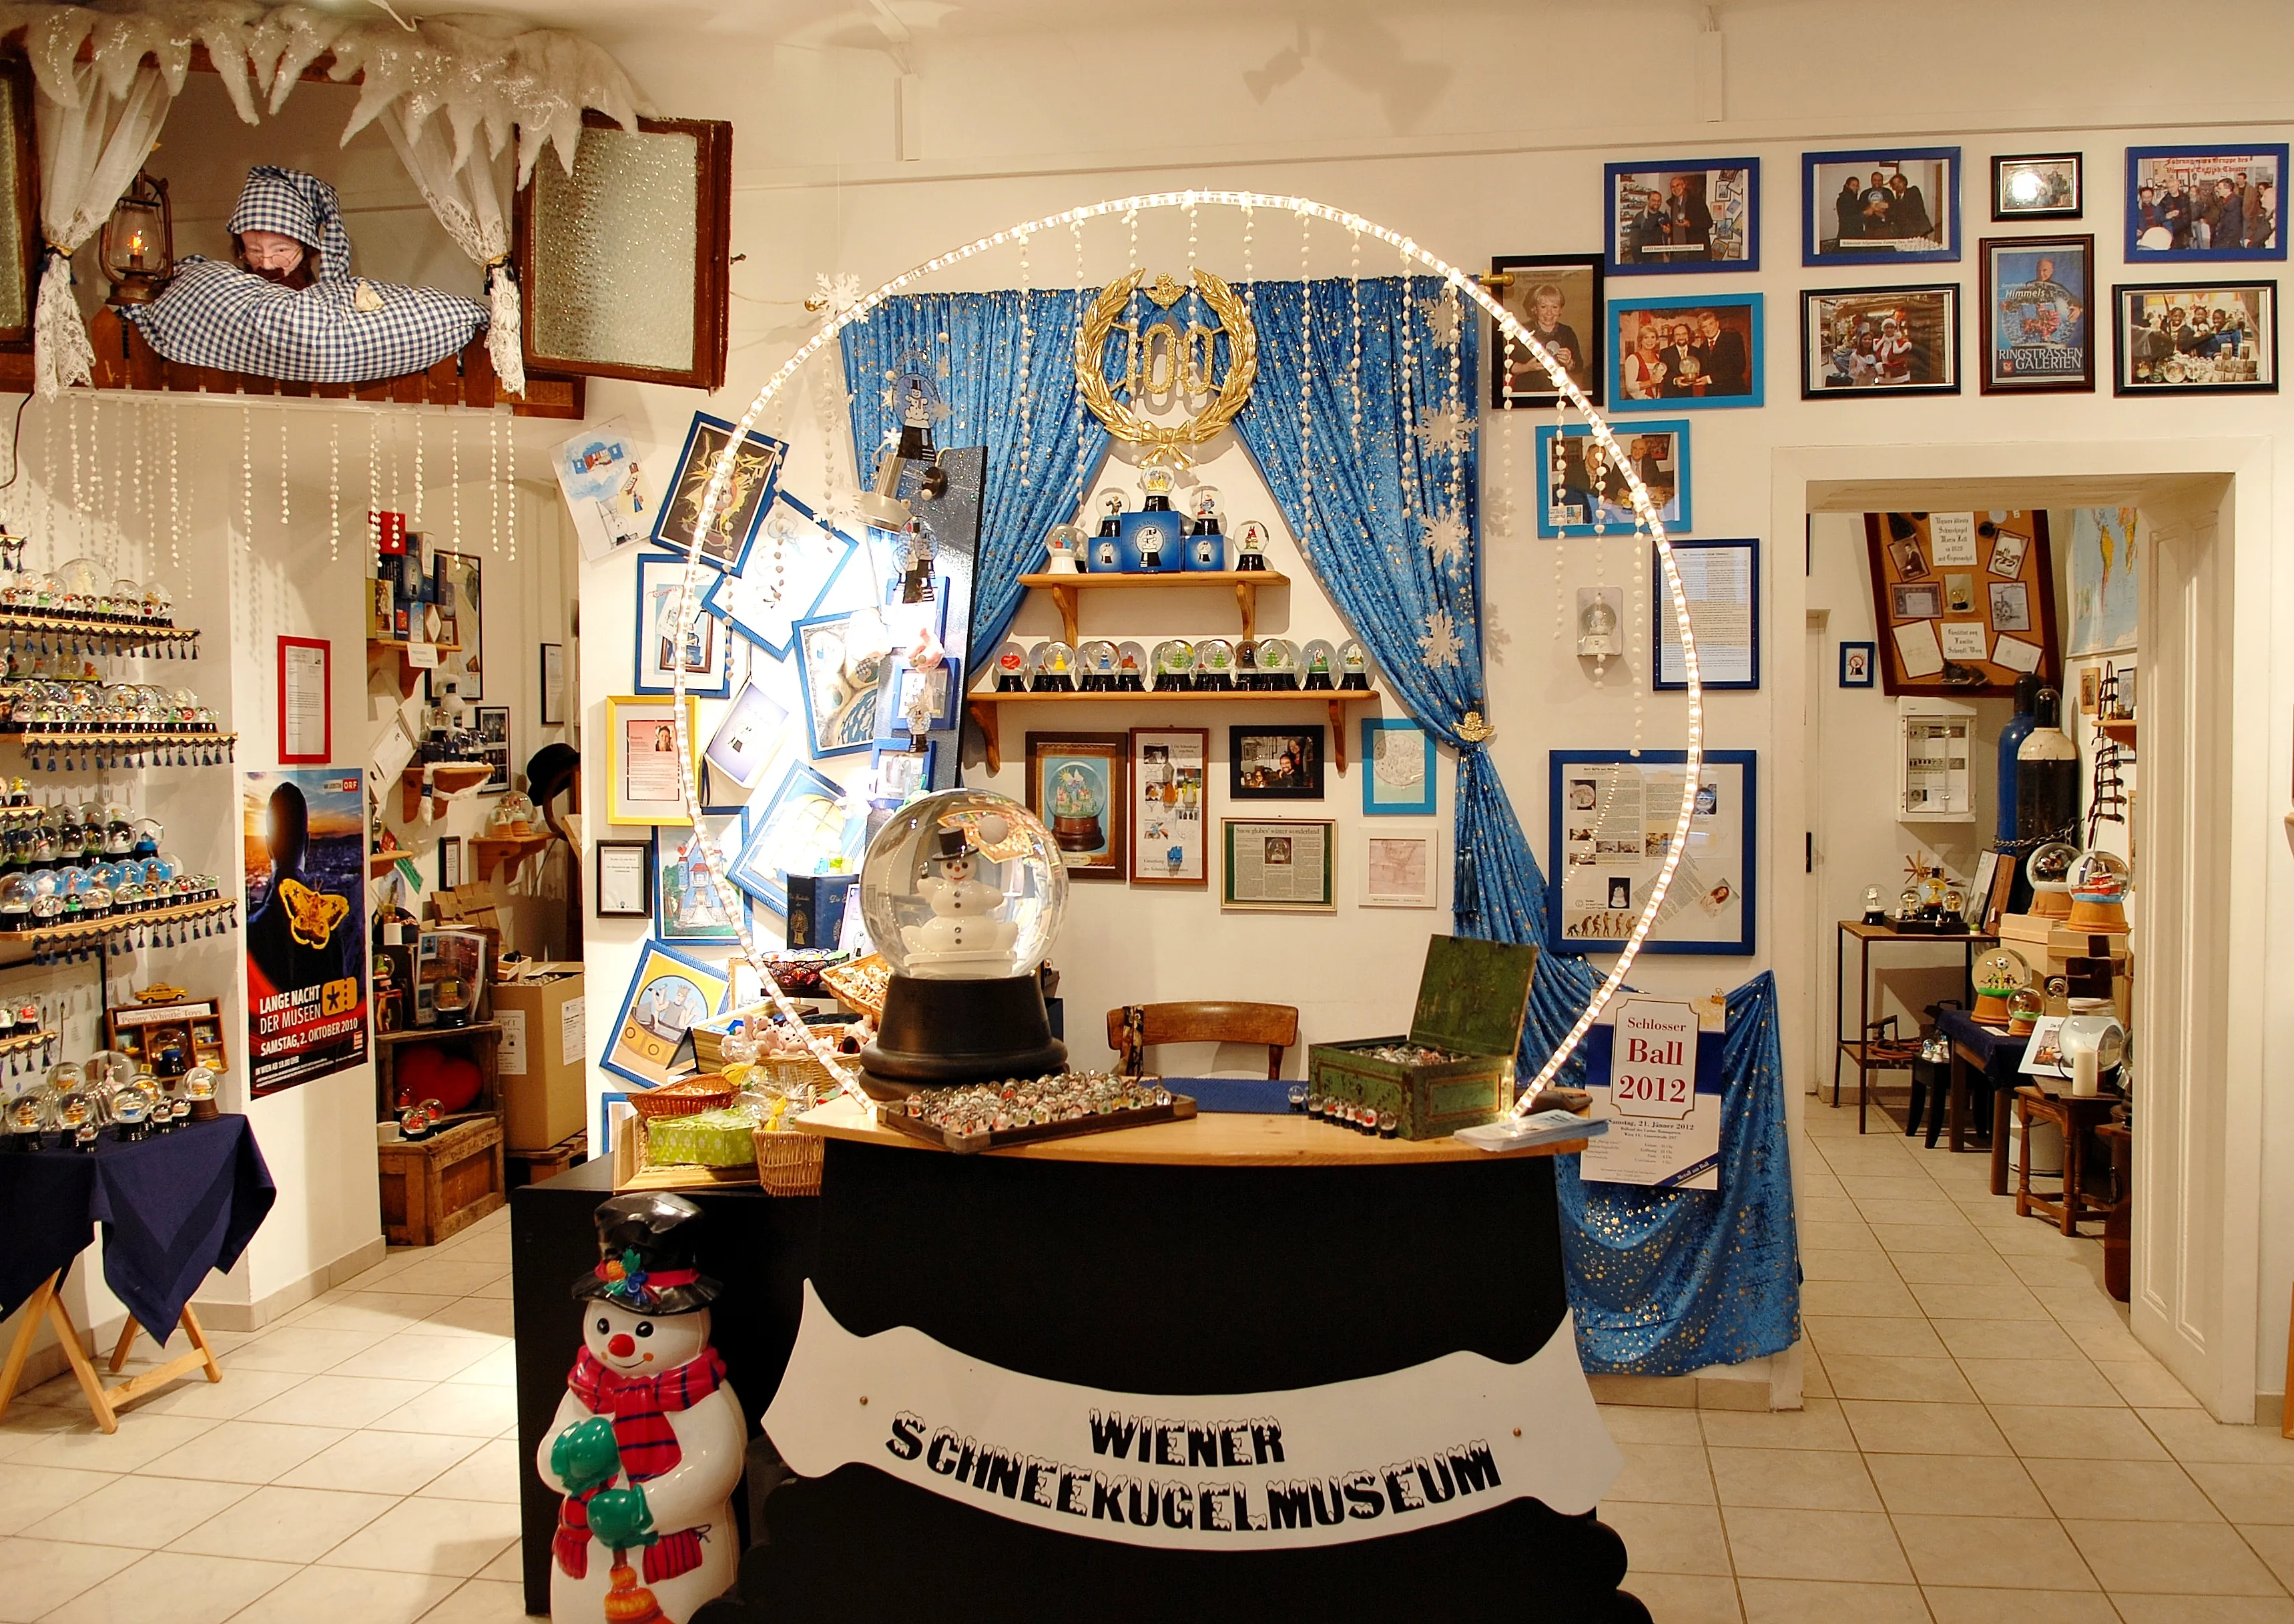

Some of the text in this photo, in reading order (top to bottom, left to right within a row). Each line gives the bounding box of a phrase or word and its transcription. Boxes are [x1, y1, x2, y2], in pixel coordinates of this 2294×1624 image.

[2005, 289, 2046, 298] Himmels
[1127, 322, 1214, 395] 100
[1999, 348, 2083, 360] RINGSTRASSEN
[2015, 356, 2081, 370] GALERIEN
[343, 781, 358, 790] ORF
[259, 985, 321, 1015] LANGE NACHT
[121, 1015, 148, 1024] Penny
[150, 1009, 182, 1021] Whistle
[184, 1009, 203, 1017] Toys
[260, 1003, 322, 1035] DER MUSEEN
[1627, 1017, 1687, 1032] Schlosser
[260, 1035, 300, 1057] SAMSTAG,
[300, 1032, 308, 1045] 2.
[308, 1022, 341, 1043] OKTOBER
[340, 1017, 358, 1033] 2010
[1627, 1038, 1683, 1066] Ball
[1619, 1075, 1686, 1103] 2012
[1608, 1119, 1637, 1127] Samstag,
[1651, 1121, 1674, 1129] Jänner
[1087, 1407, 1285, 1468] WIENER
[884, 1410, 1503, 1533] SCHNEEKUGELMUSEUM
